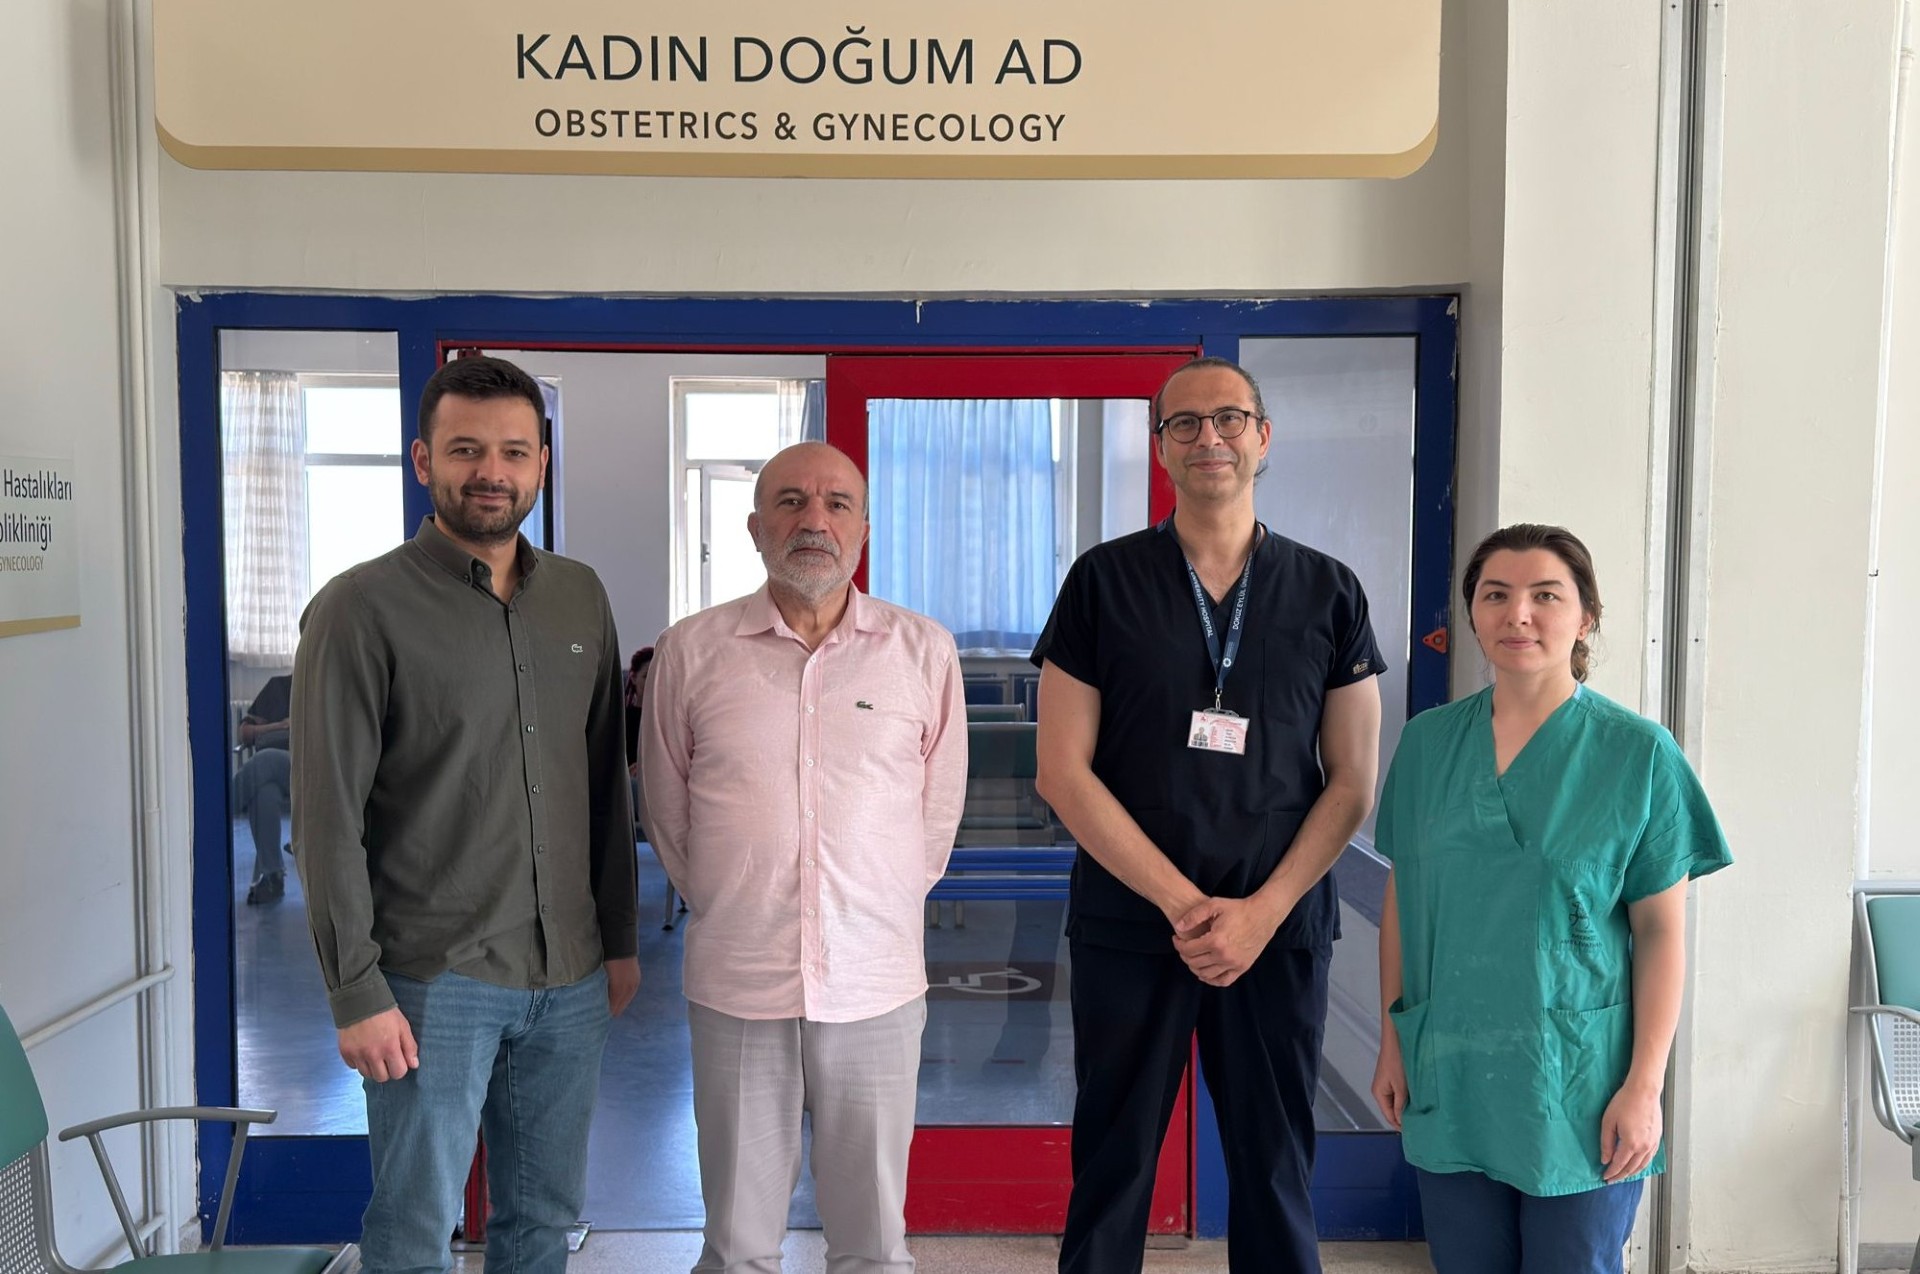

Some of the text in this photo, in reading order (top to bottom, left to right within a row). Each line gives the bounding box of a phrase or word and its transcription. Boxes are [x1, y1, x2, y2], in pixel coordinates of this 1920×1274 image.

[516, 25, 1082, 85] KADIN DOĞUM AD
[534, 108, 1066, 142] OBSTETRICS & GYNECOLOGY
[3, 468, 72, 500] Hastalıkları
[1201, 606, 1214, 638] HOSPITAL
[1232, 608, 1242, 630] DOKUZ
